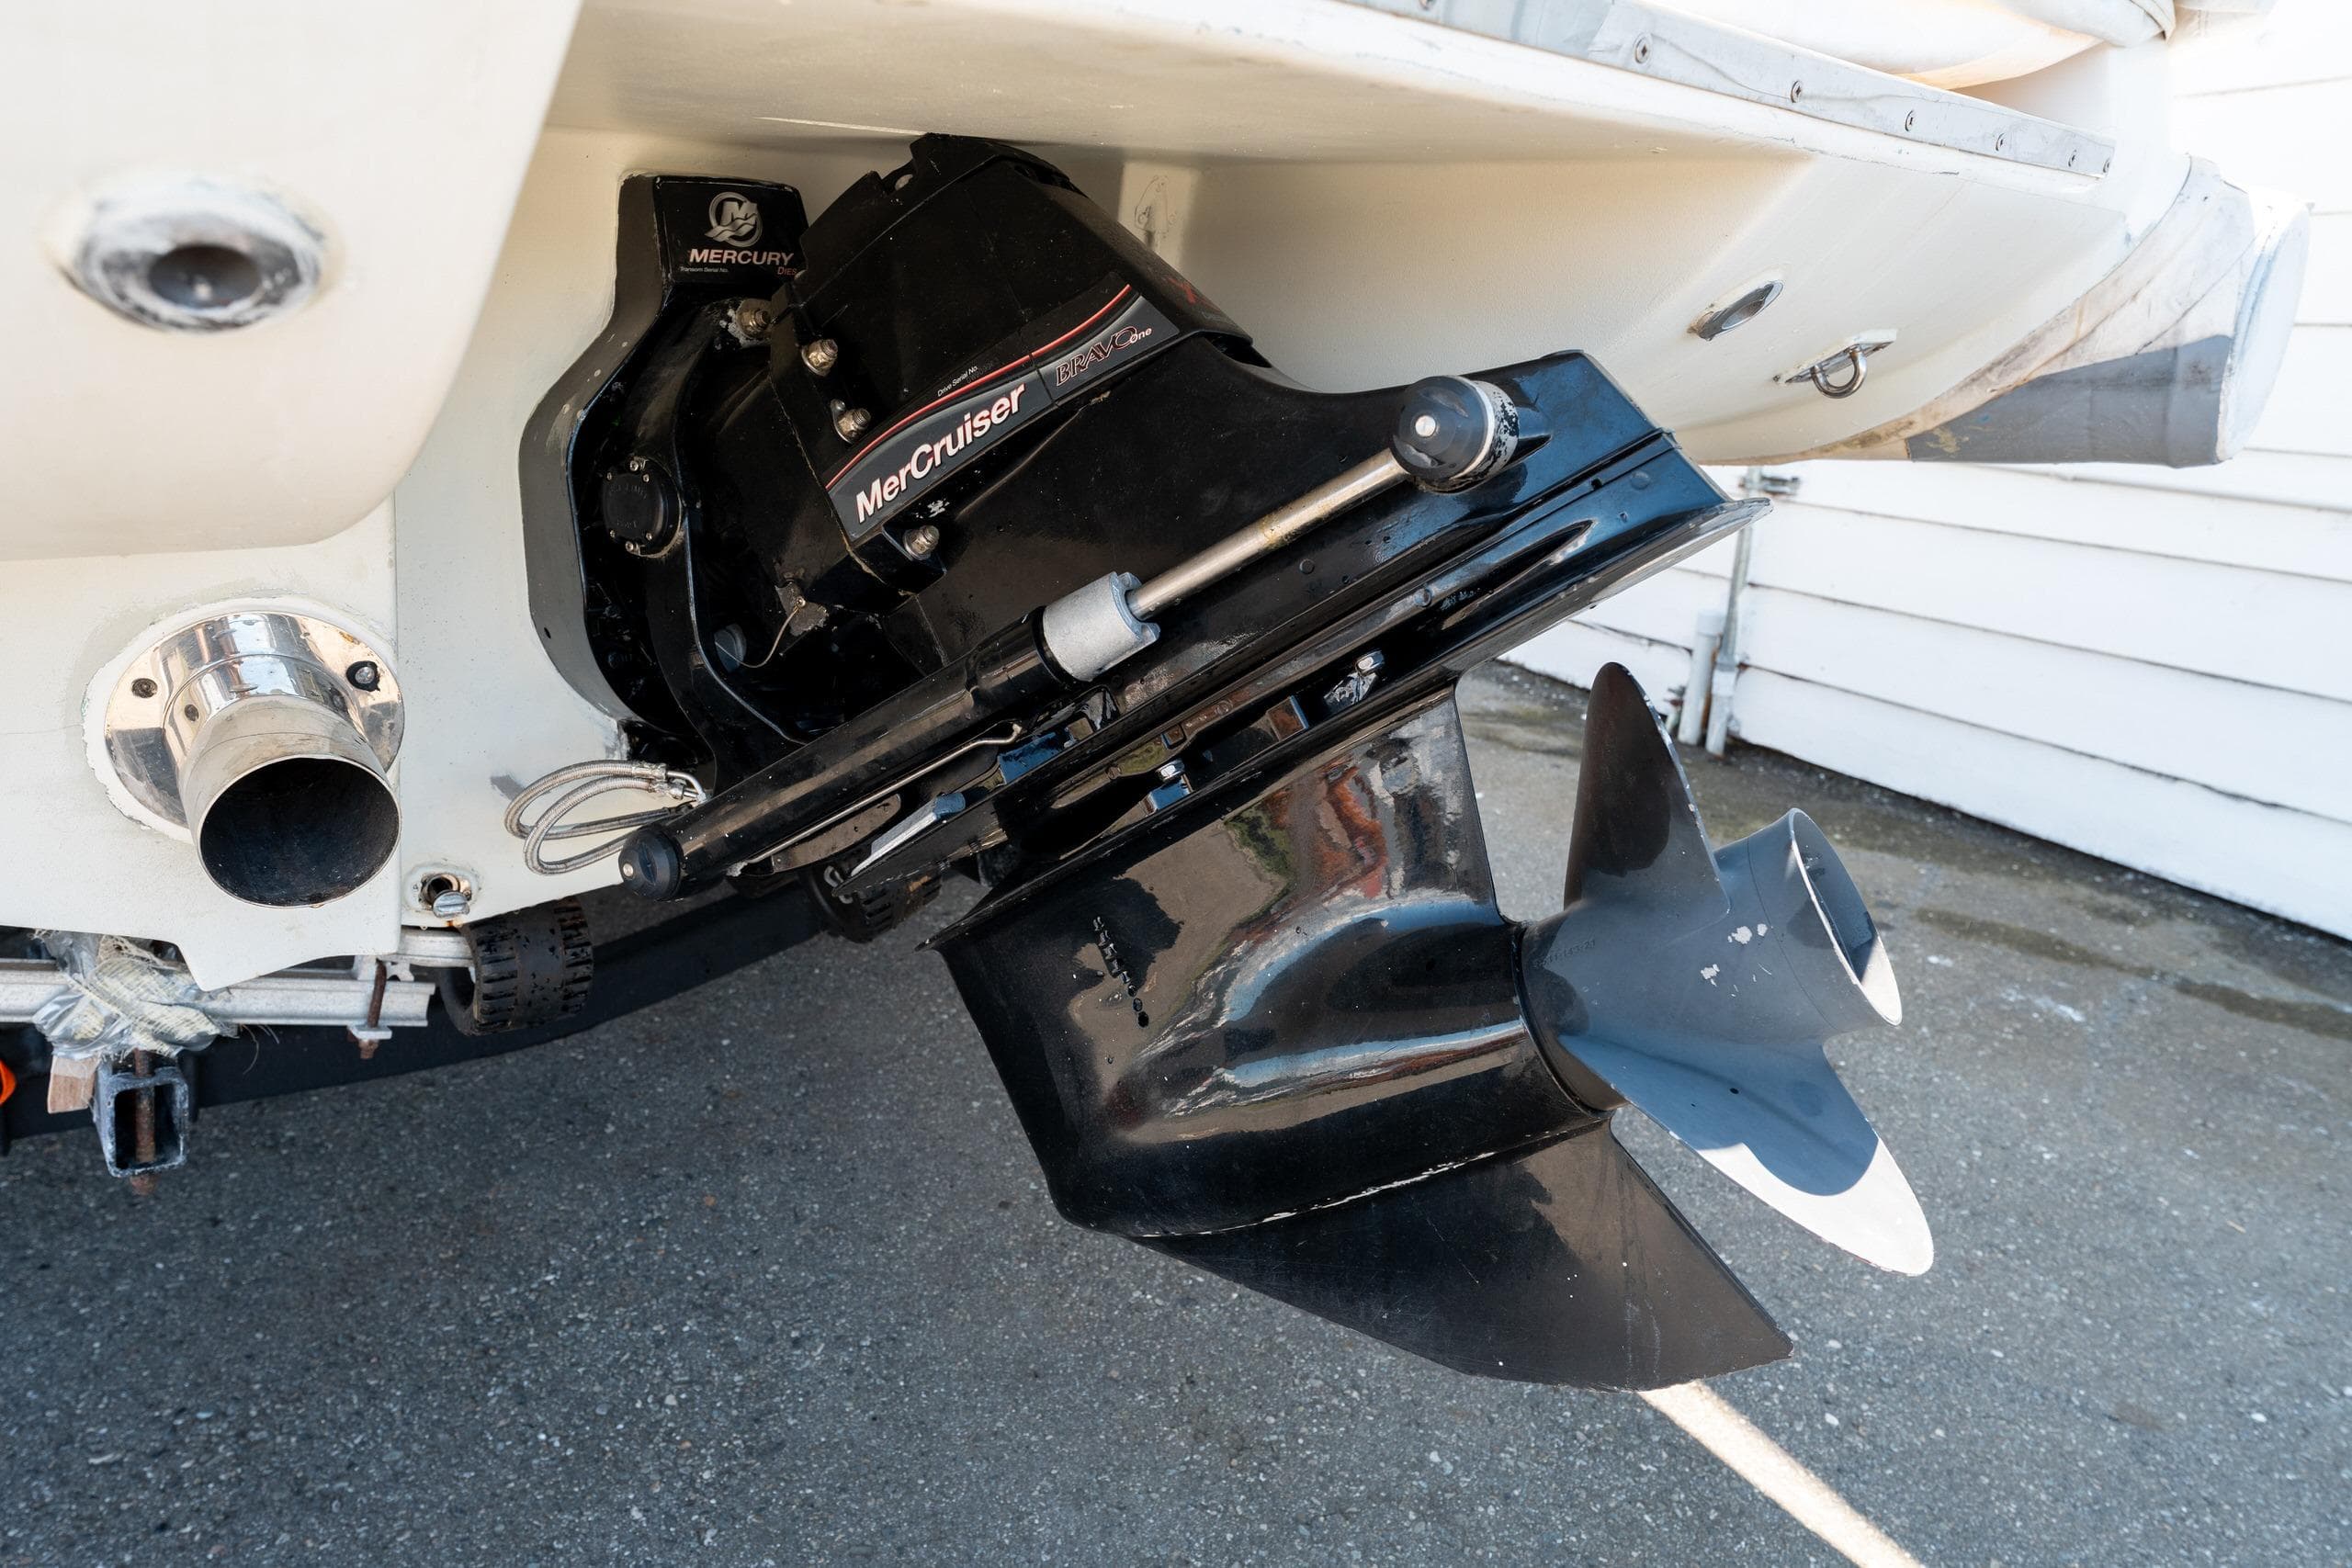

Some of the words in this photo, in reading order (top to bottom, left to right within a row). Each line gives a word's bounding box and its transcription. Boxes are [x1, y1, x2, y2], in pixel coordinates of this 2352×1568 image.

[689, 248, 794, 265] MERCURY
[1056, 325, 1137, 387] BRAVO
[937, 384, 953, 397] Drive
[953, 371, 968, 387] Serial
[968, 366, 978, 375] No.
[855, 383, 1025, 524] MerCruiser
